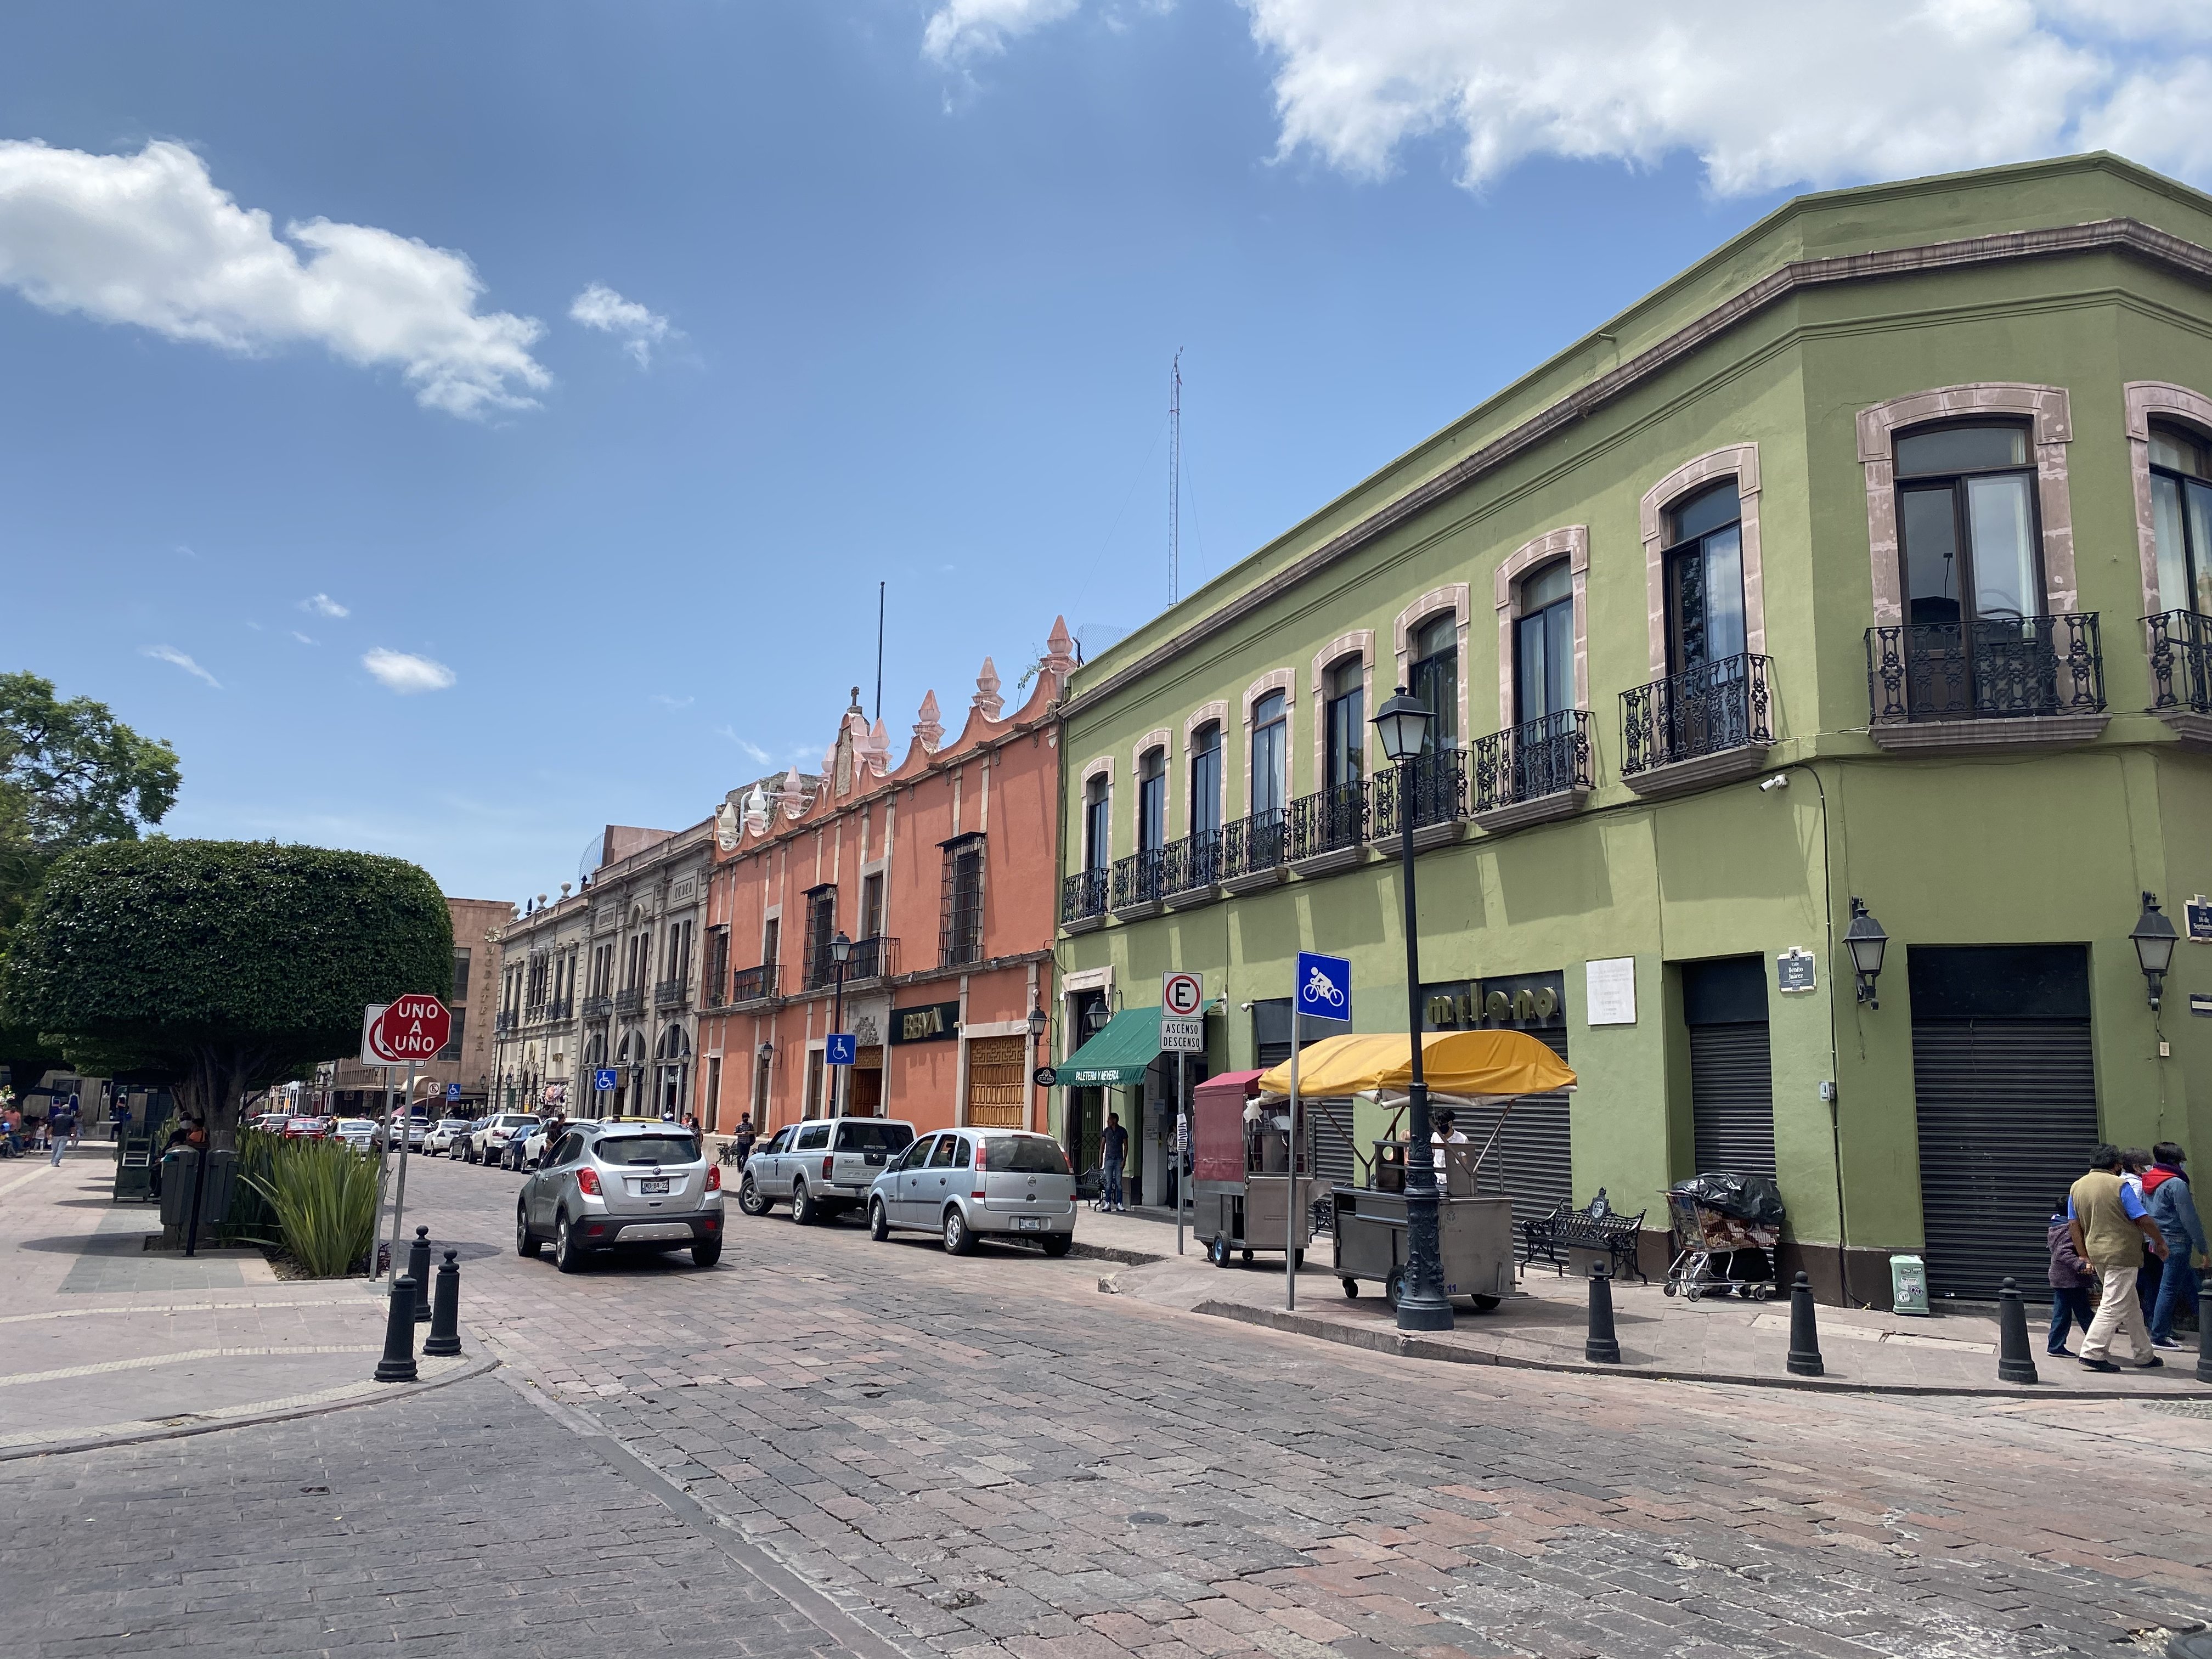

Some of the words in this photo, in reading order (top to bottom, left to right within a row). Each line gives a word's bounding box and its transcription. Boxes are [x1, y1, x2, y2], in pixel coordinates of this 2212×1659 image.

[1176, 983, 1190, 1007] E
[398, 1003, 438, 1019] UNO
[1427, 983, 1558, 1024] milano
[409, 1020, 422, 1035] A
[903, 1007, 944, 1040] BBVA
[1166, 1023, 1198, 1035] ASCENSO
[394, 1035, 435, 1052] UNO
[1163, 1036, 1200, 1048] DESCENSO
[1075, 1071, 1097, 1081] PALETERIA
[1097, 1071, 1101, 1081] Y
[1101, 1070, 1119, 1080] NEVERIA
[1447, 1284, 1457, 1293] 11
